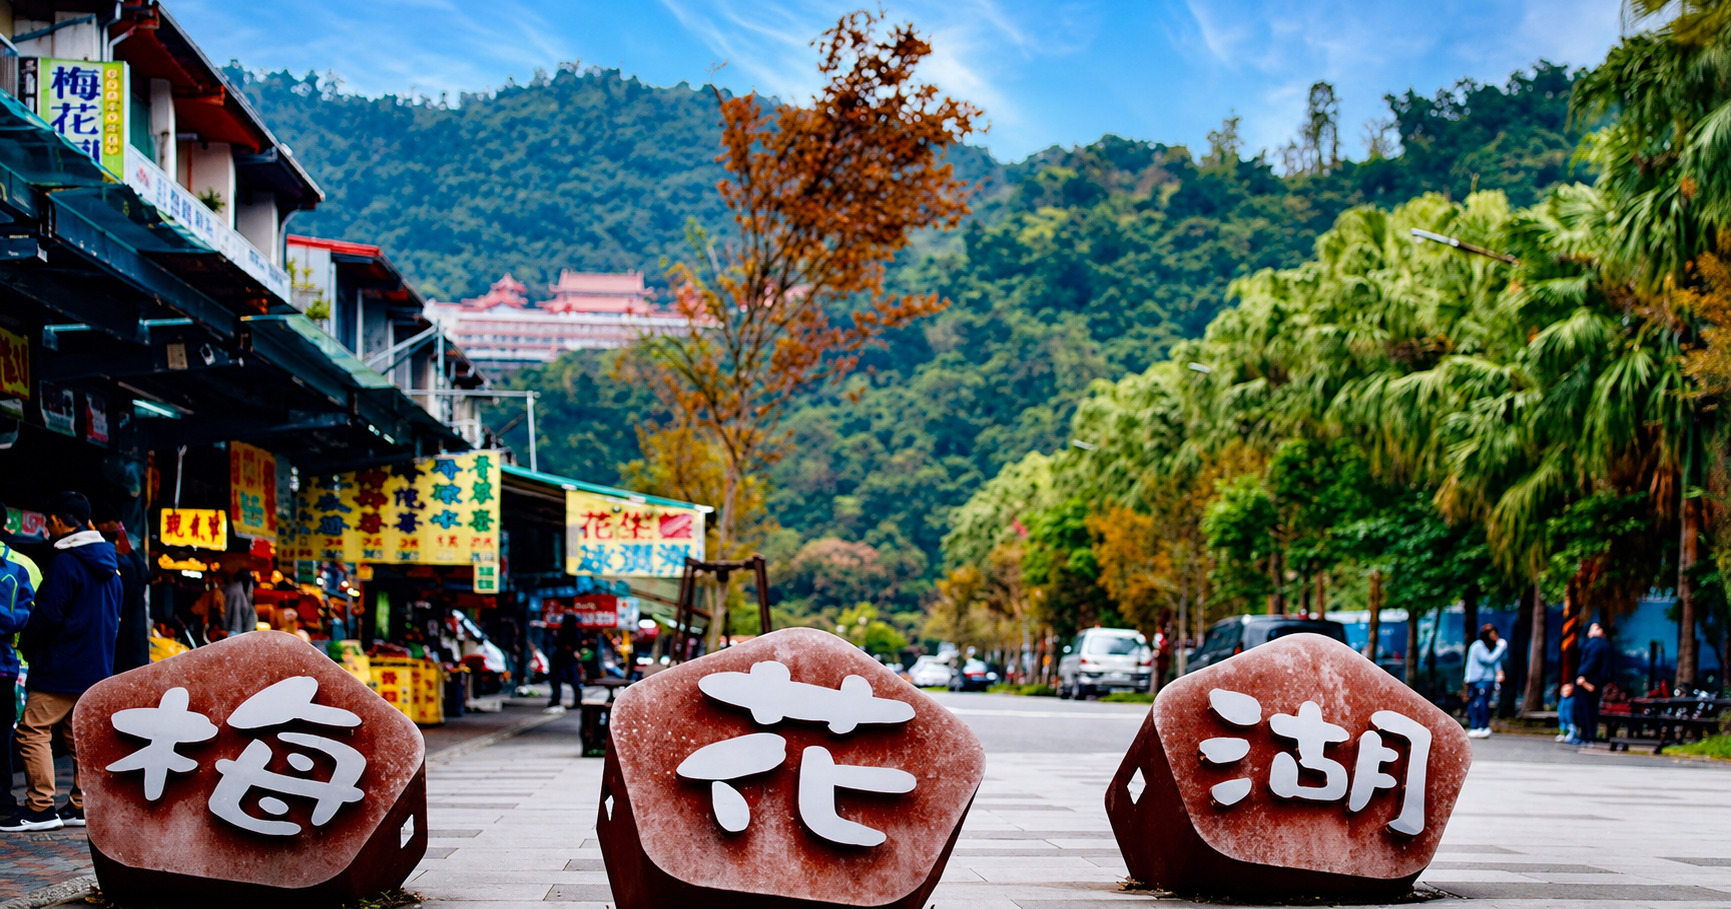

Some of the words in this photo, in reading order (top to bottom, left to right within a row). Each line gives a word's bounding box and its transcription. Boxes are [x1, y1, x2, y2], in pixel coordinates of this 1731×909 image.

[105, 675, 367, 836] 梅
[676, 661, 917, 847] 花
[1199, 688, 1432, 836] 湖
